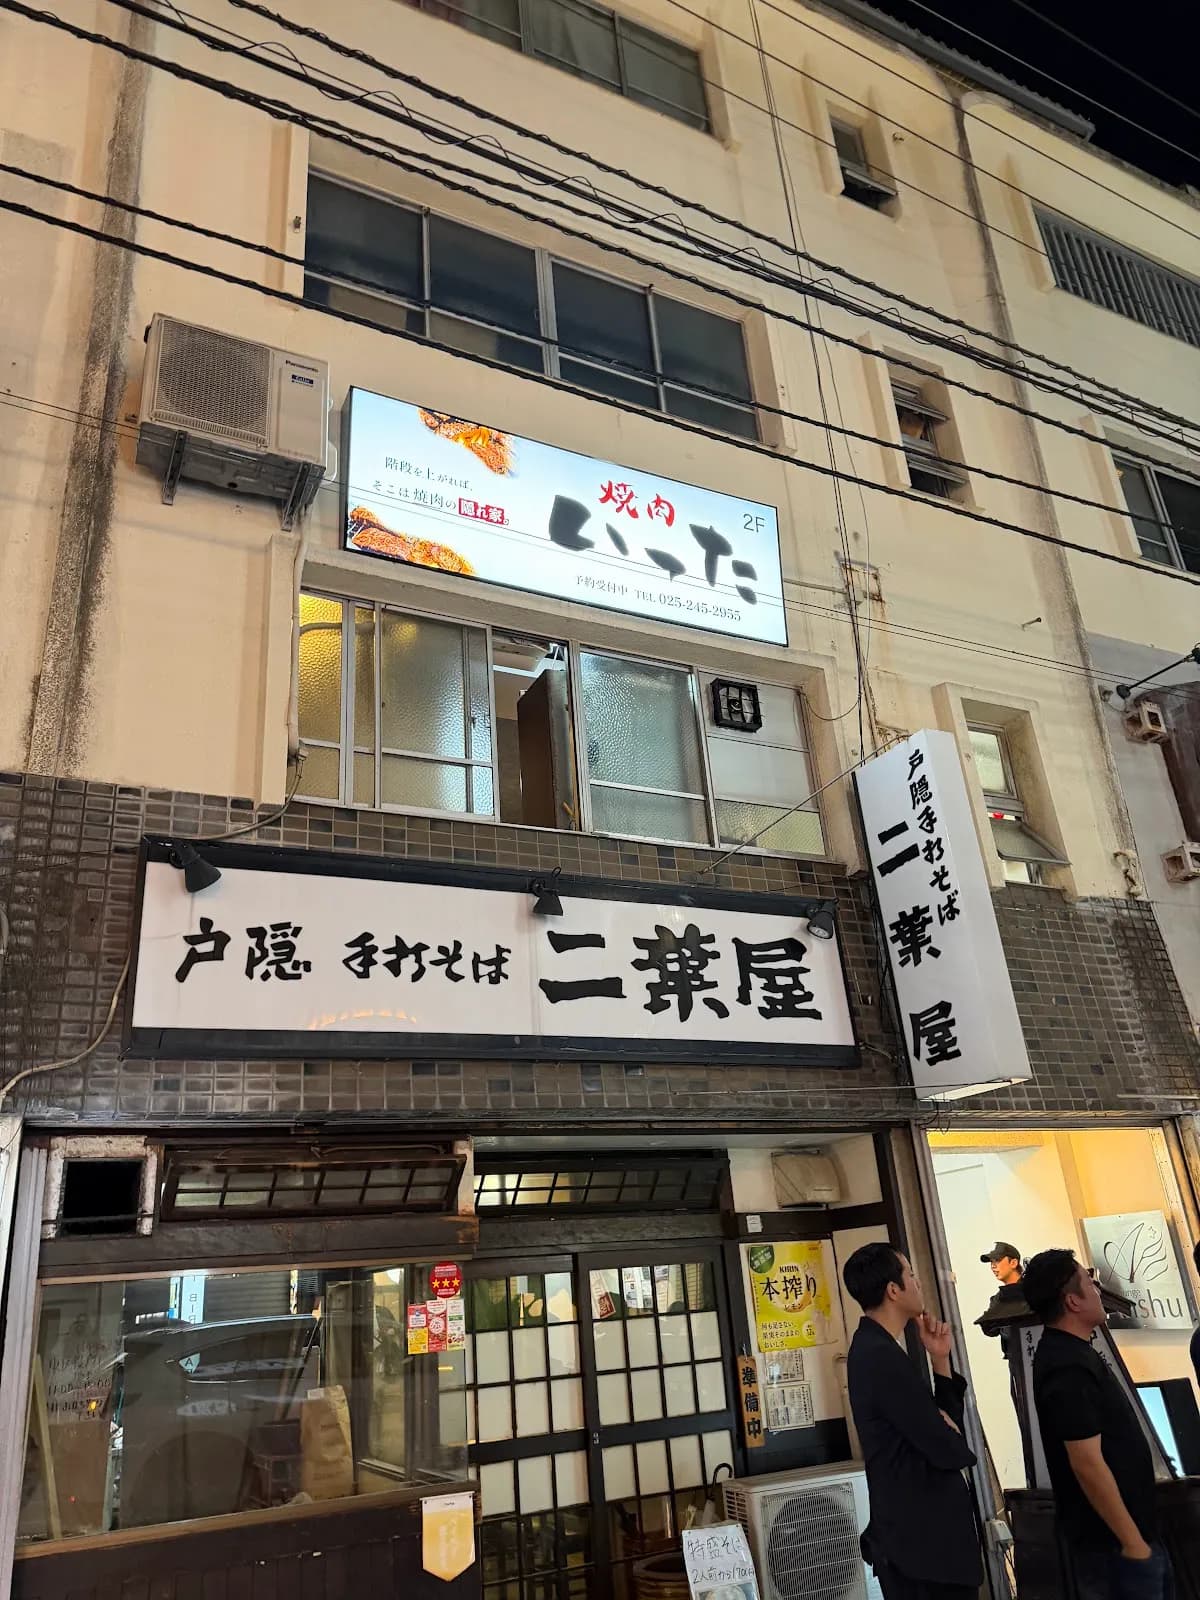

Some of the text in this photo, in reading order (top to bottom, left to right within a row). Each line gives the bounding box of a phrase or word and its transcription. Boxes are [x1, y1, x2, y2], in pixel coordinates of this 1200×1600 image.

[599, 480, 676, 528] 焼肉
[743, 513, 767, 533] 2F
[576, 575, 741, 622] 予約受付中 TEL 025-245-2955
[876, 820, 962, 1067] 二葉屋
[343, 931, 512, 985] 手打そば
[539, 923, 823, 1023] 二葉屋
[760, 1274, 817, 1301] 本搾り
[780, 1265, 800, 1273] KIRIN
[742, 1366, 761, 1439] 準備中
